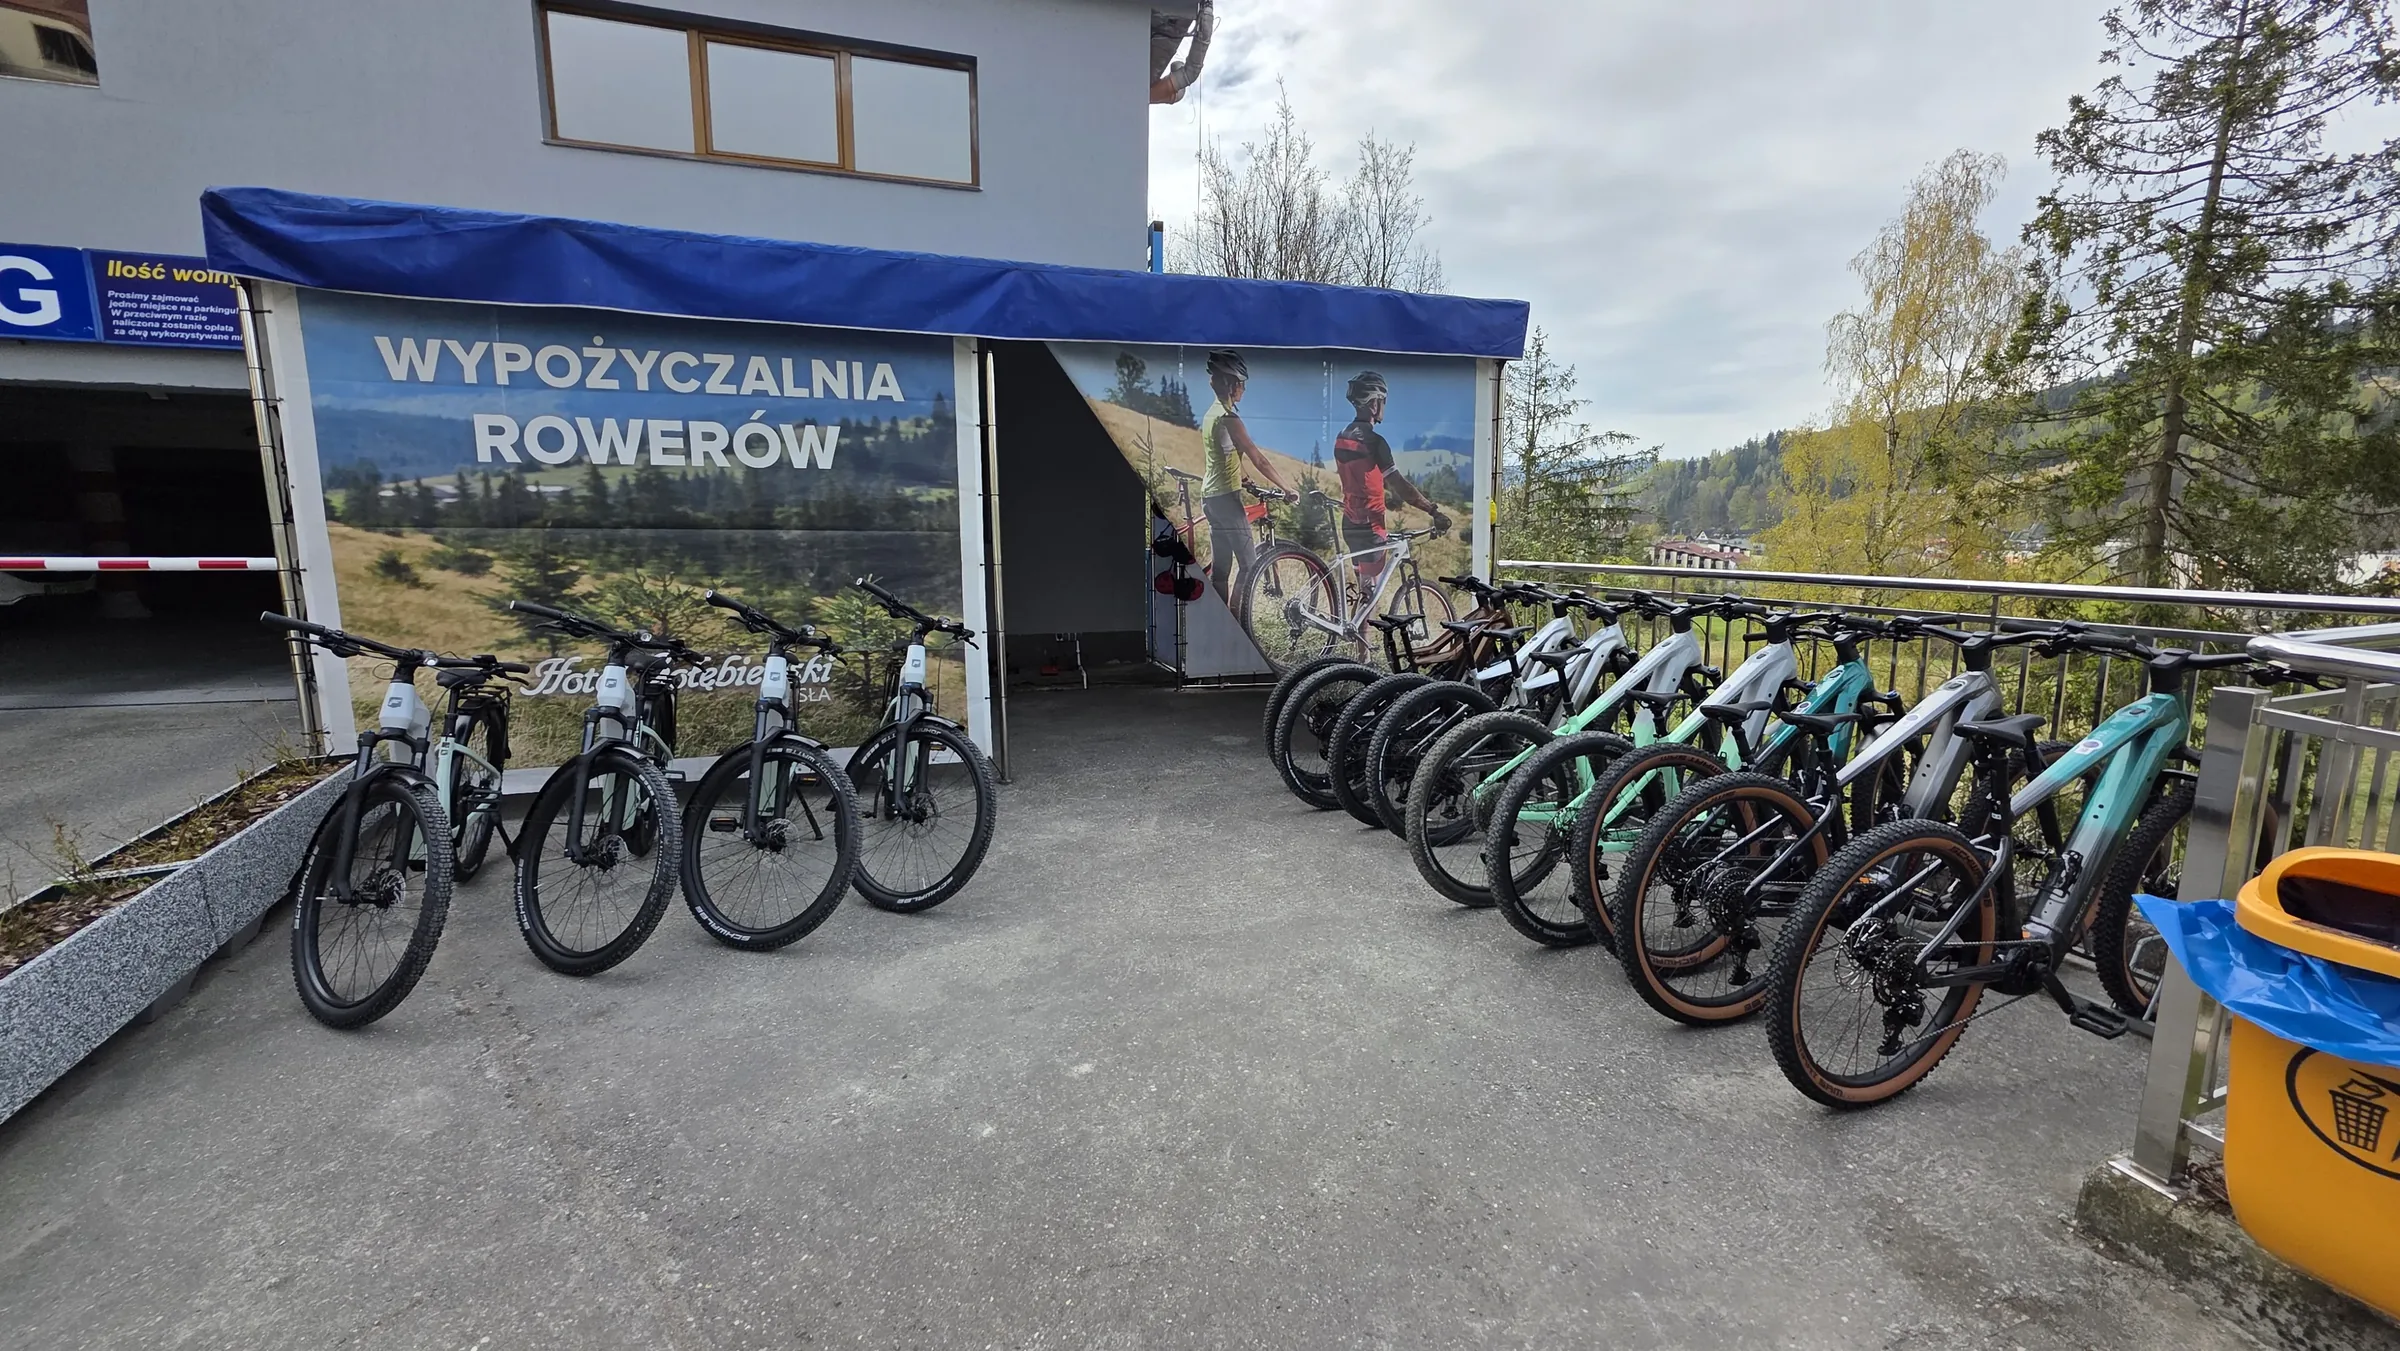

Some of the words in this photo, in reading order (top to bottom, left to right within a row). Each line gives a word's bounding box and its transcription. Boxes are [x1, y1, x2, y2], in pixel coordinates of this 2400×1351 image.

[107, 260, 166, 280] Ilość
[172, 268, 237, 289] wolny
[107, 290, 149, 301] Prosimy
[151, 294, 199, 303] zajmować
[108, 300, 138, 309] jedno
[140, 302, 178, 311] miejsce
[194, 304, 239, 316] parkingu!
[111, 309, 122, 317] W
[123, 309, 182, 320] przeciwnym
[184, 313, 208, 321] razie
[112, 319, 160, 328] naliczona
[162, 322, 202, 330] zostanie
[150, 330, 229, 341] wykorzystywane
[373, 335, 905, 402] WYPOŻYCZALNIA
[472, 409, 842, 470] ROWERÓW
[798, 686, 833, 703] SŁA
[293, 844, 320, 930] SCHWALBE
[517, 858, 532, 931] SCHWALBE
[896, 875, 954, 904] SCHWALBE
[694, 905, 752, 942] SCHWALBE
